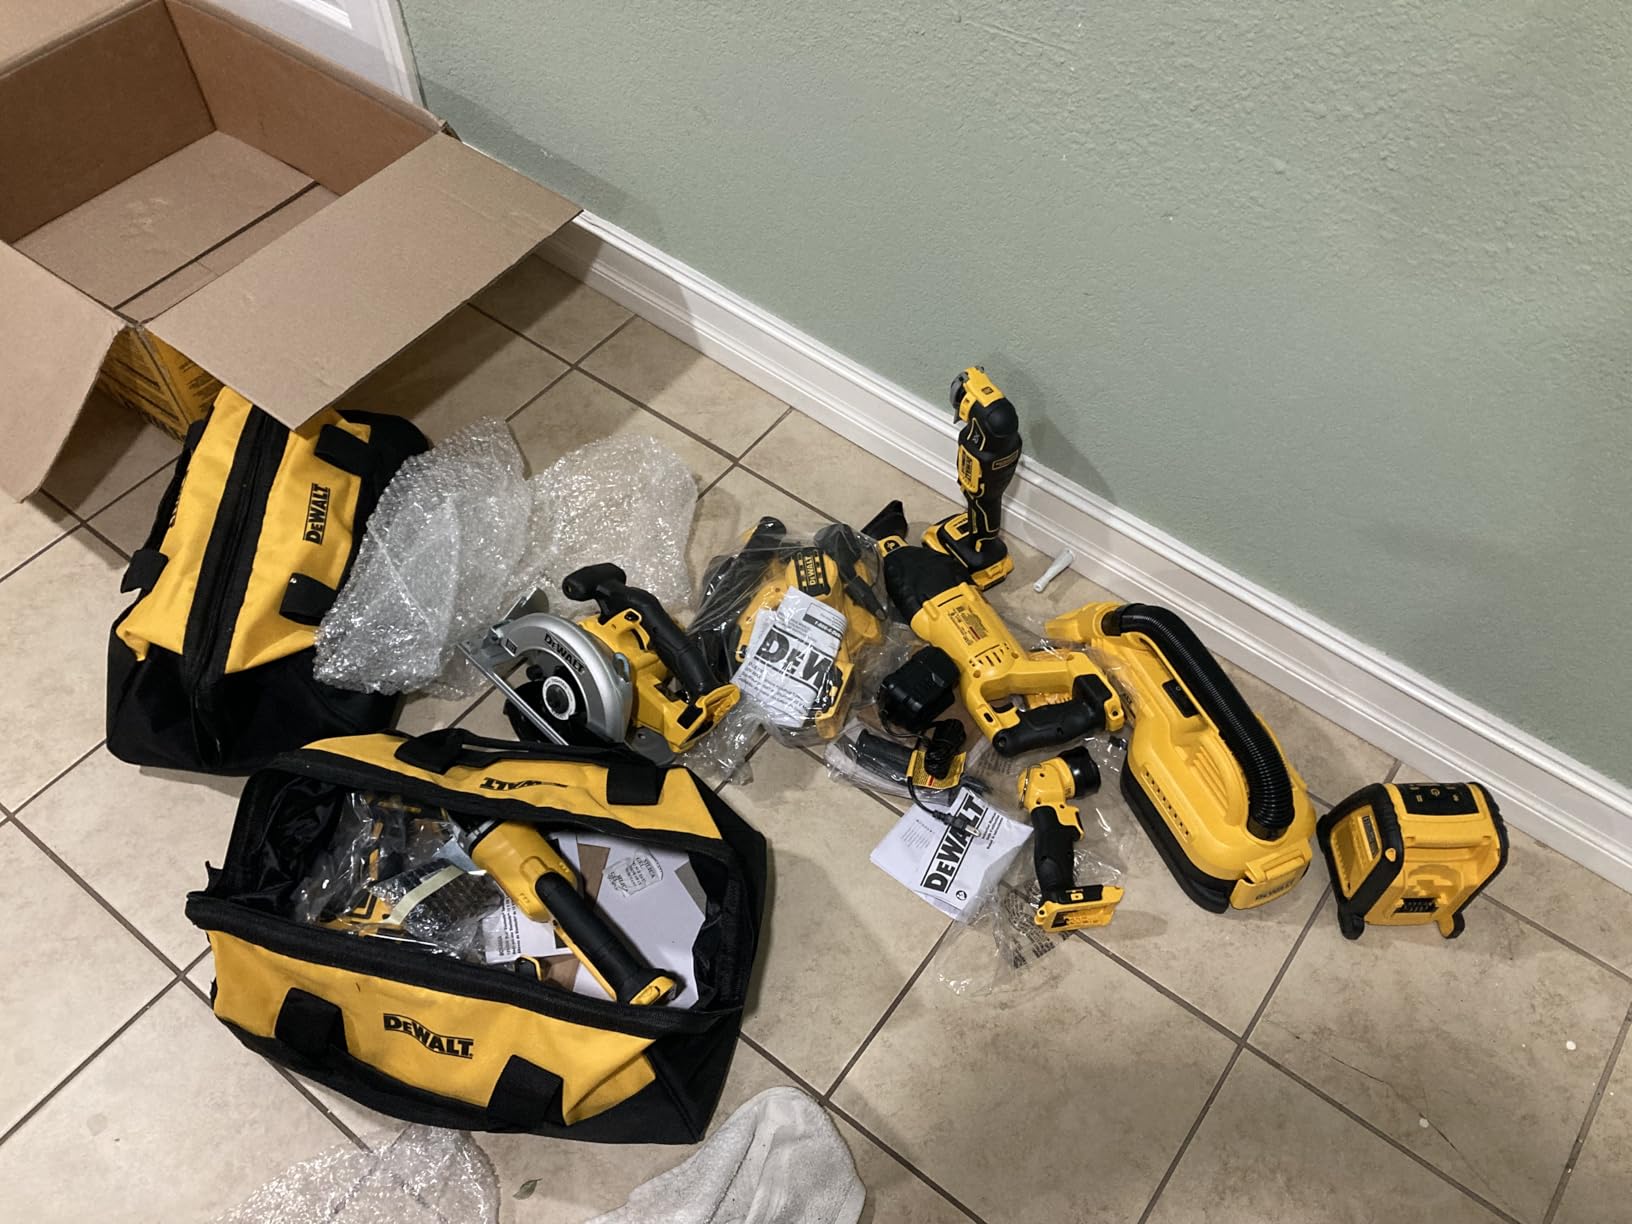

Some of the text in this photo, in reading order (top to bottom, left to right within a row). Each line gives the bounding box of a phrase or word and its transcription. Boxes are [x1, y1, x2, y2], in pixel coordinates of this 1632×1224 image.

[304, 484, 329, 543] DEWALT
[544, 633, 586, 674] DEWALT
[924, 796, 985, 892] DEWALT
[383, 1013, 474, 1057] DEWALT
